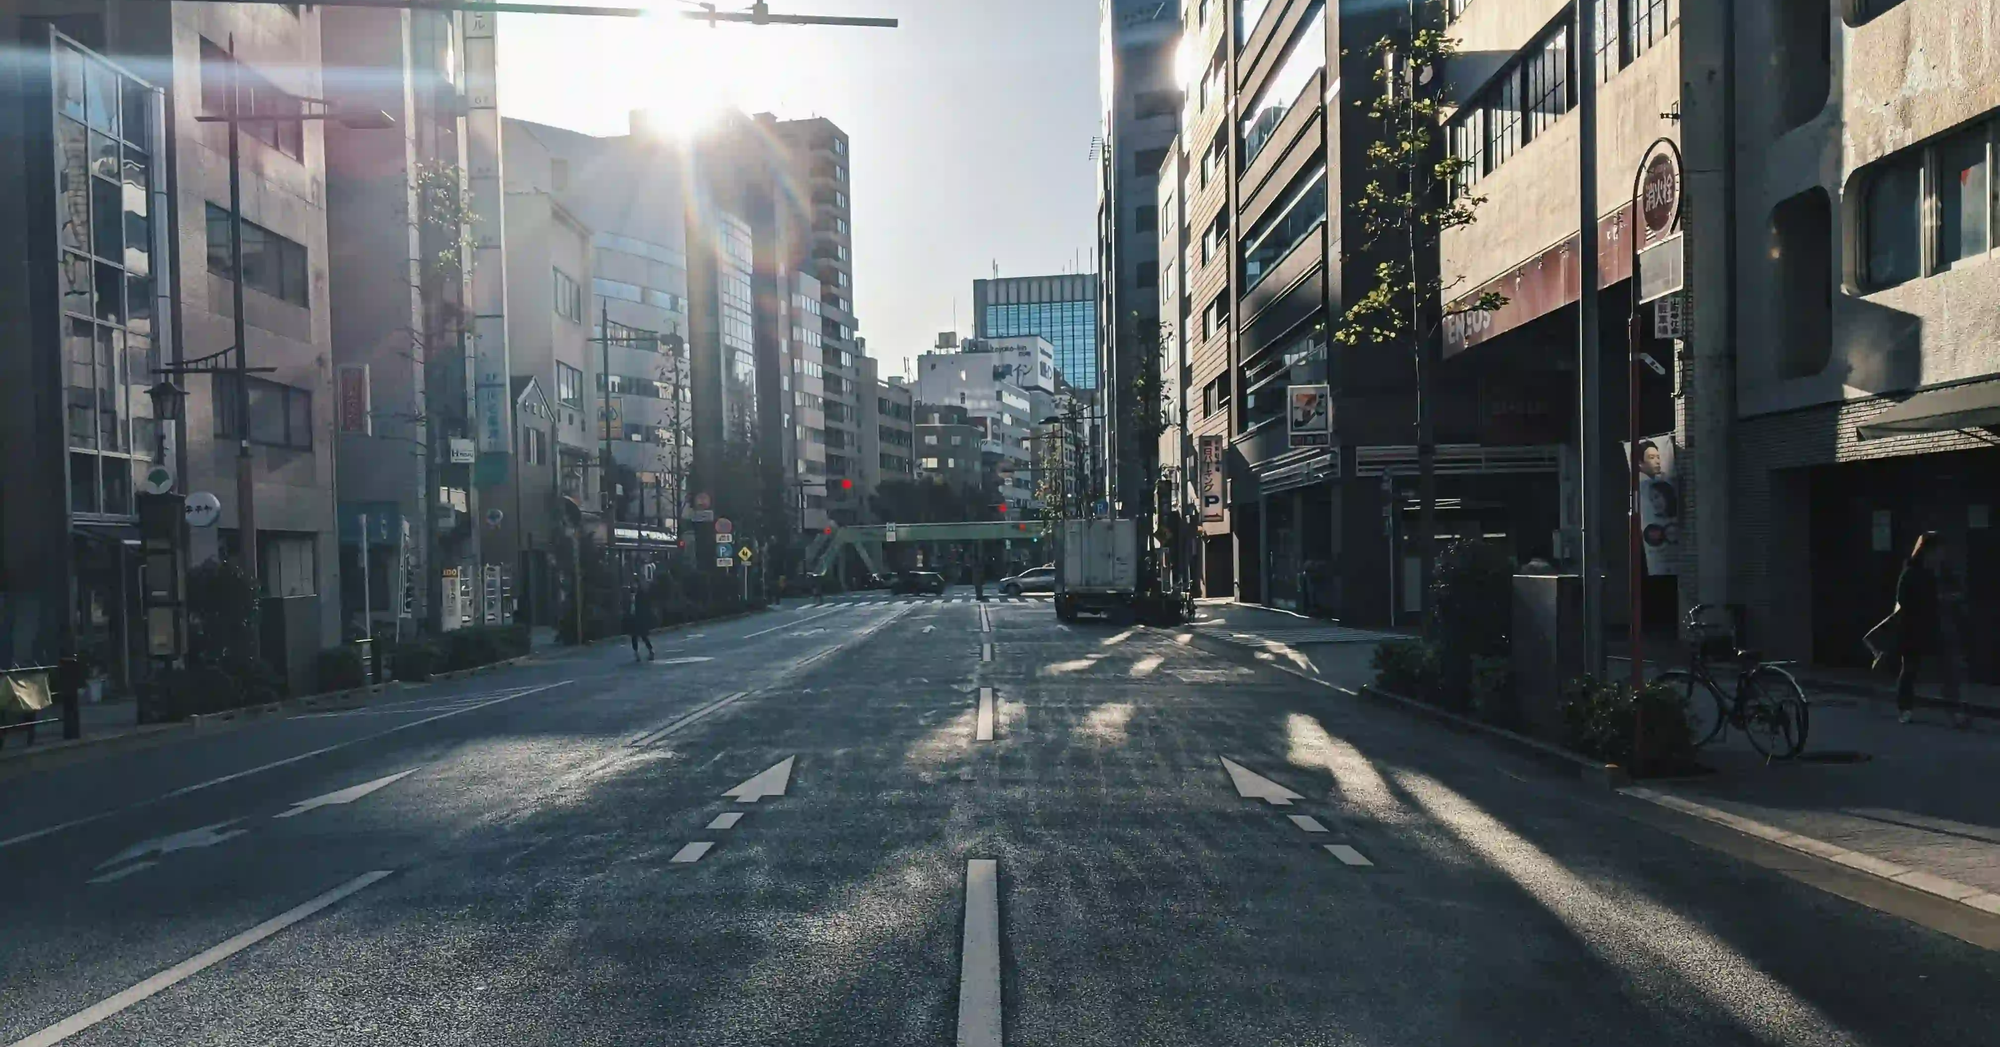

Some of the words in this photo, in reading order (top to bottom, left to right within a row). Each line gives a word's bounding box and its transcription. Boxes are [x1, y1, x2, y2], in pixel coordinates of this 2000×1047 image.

[1645, 173, 1673, 212] 消火栓
[1204, 495, 1220, 508] P
[720, 546, 726, 557] P
